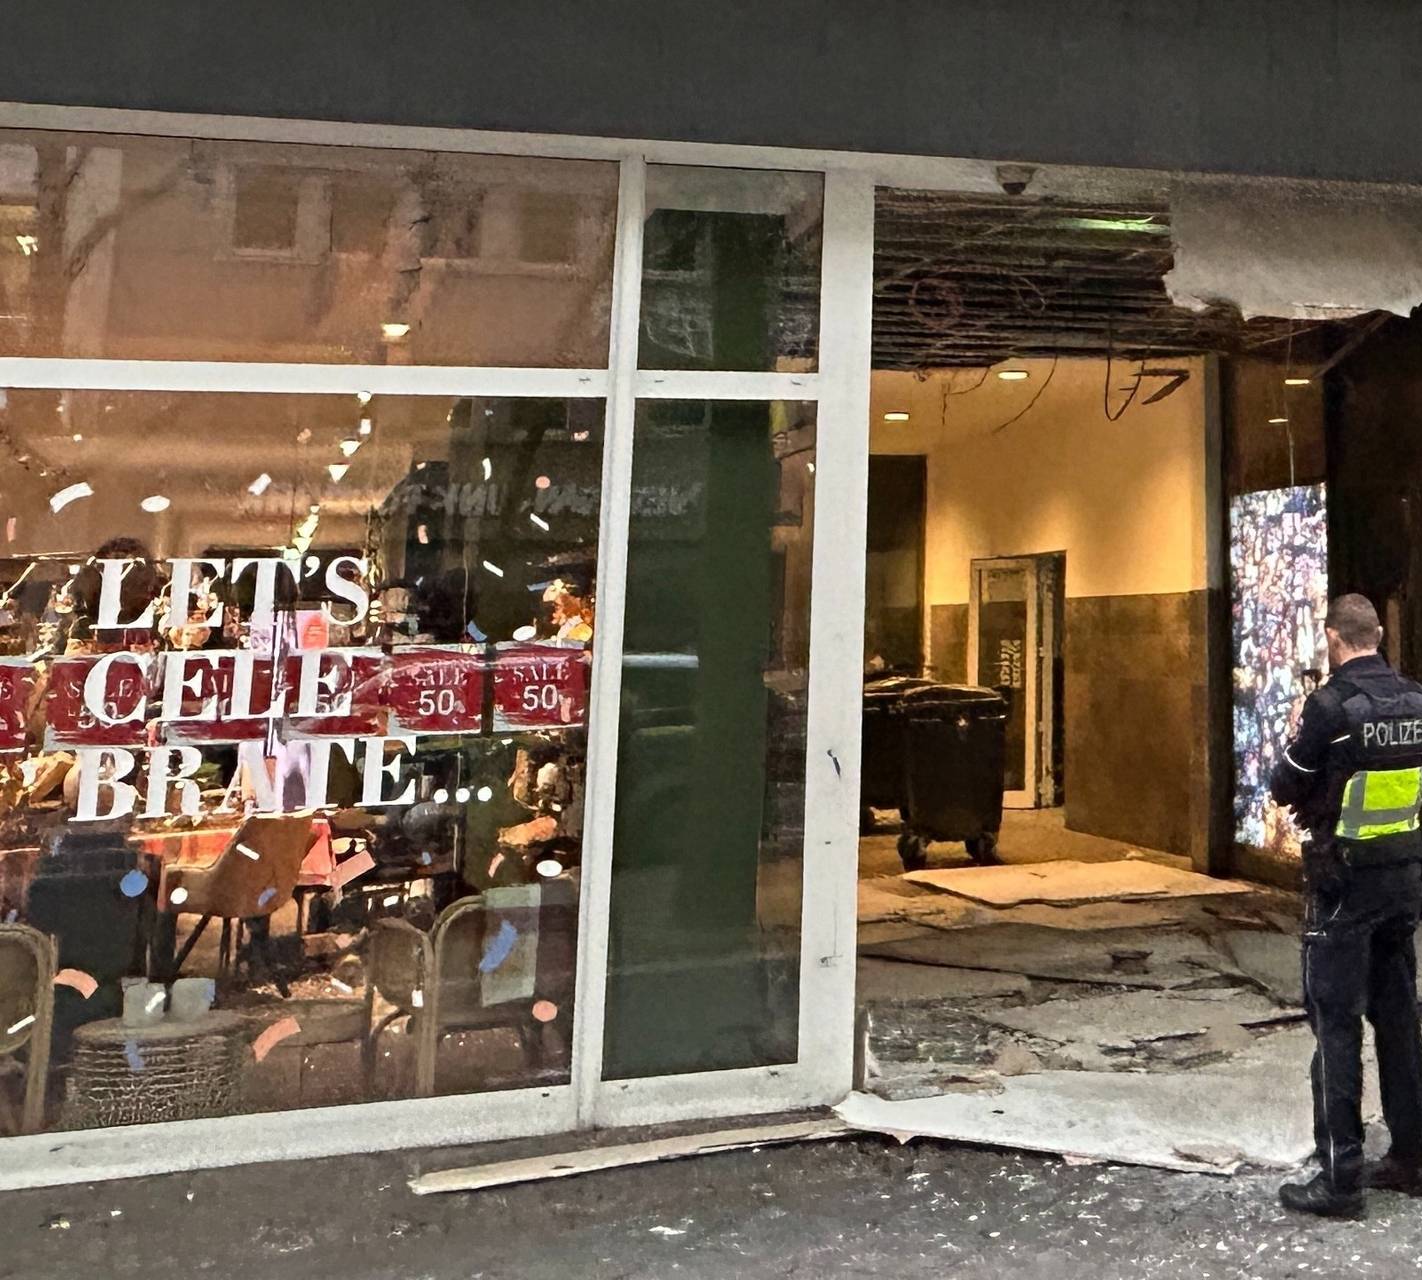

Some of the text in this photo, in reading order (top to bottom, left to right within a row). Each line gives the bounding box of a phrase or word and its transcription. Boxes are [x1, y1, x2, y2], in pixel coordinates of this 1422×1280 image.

[88, 555, 370, 630] LET'S
[513, 663, 571, 682] SALE
[83, 650, 355, 725] CELE
[522, 684, 558, 711] 50
[418, 689, 455, 716] 50
